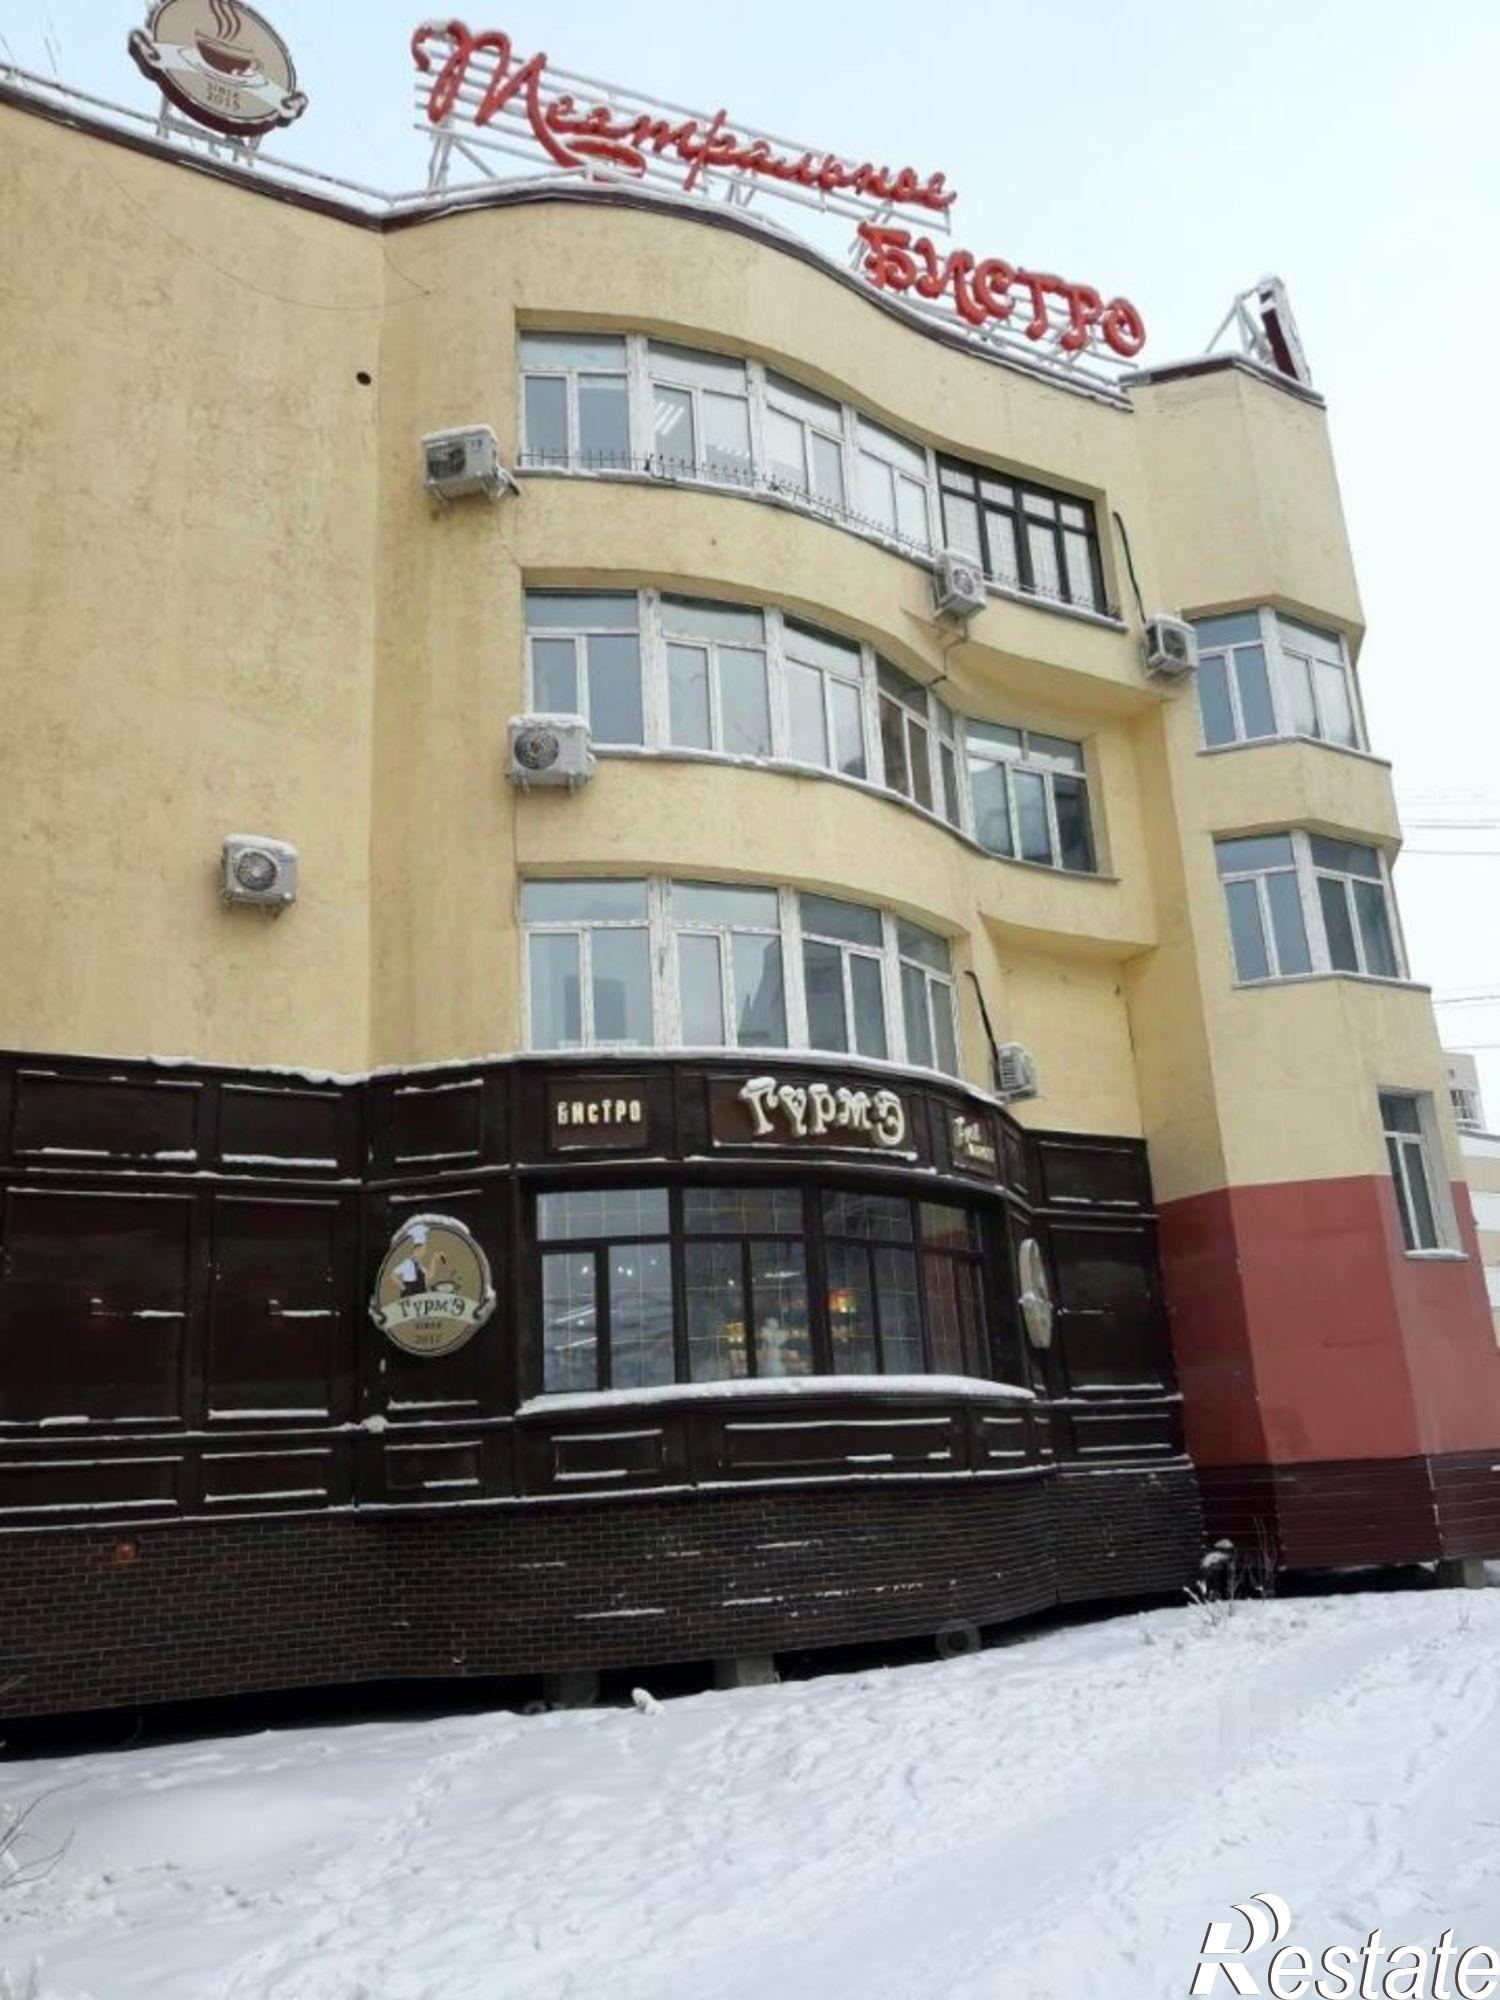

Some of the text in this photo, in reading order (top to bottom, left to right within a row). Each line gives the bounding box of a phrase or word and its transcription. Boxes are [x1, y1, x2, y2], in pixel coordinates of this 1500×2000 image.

[411, 19, 957, 209] Театральное
[857, 221, 1146, 357] БИСТРО
[557, 1099, 641, 1126] БИСТРО
